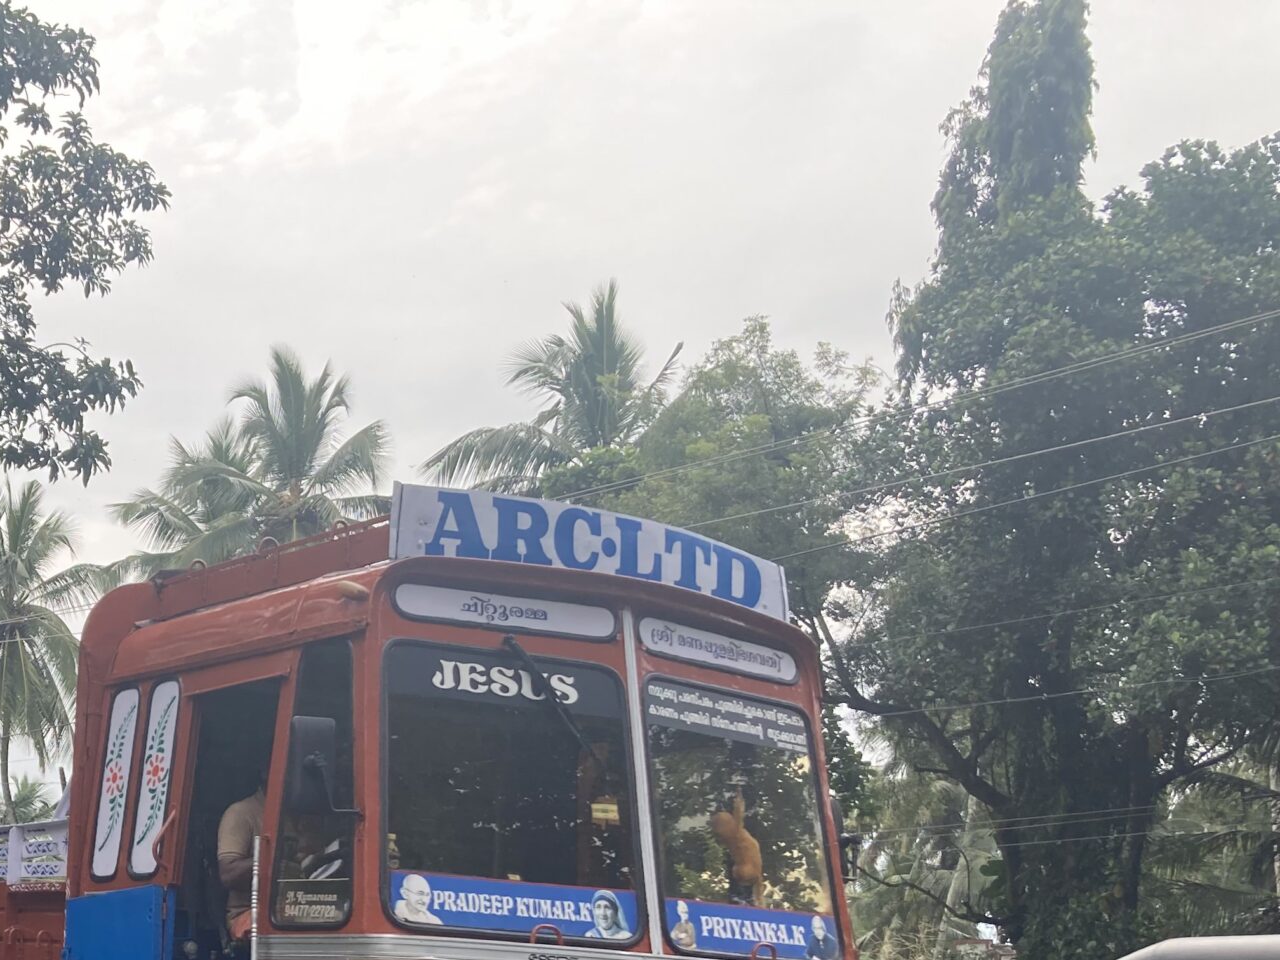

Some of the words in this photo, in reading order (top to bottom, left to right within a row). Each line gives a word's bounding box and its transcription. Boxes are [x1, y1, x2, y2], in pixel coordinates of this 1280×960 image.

[432, 890, 513, 916] PRADEEP
[516, 897, 593, 922] KUMAR.K
[700, 915, 806, 946] PRIYANKA.K
